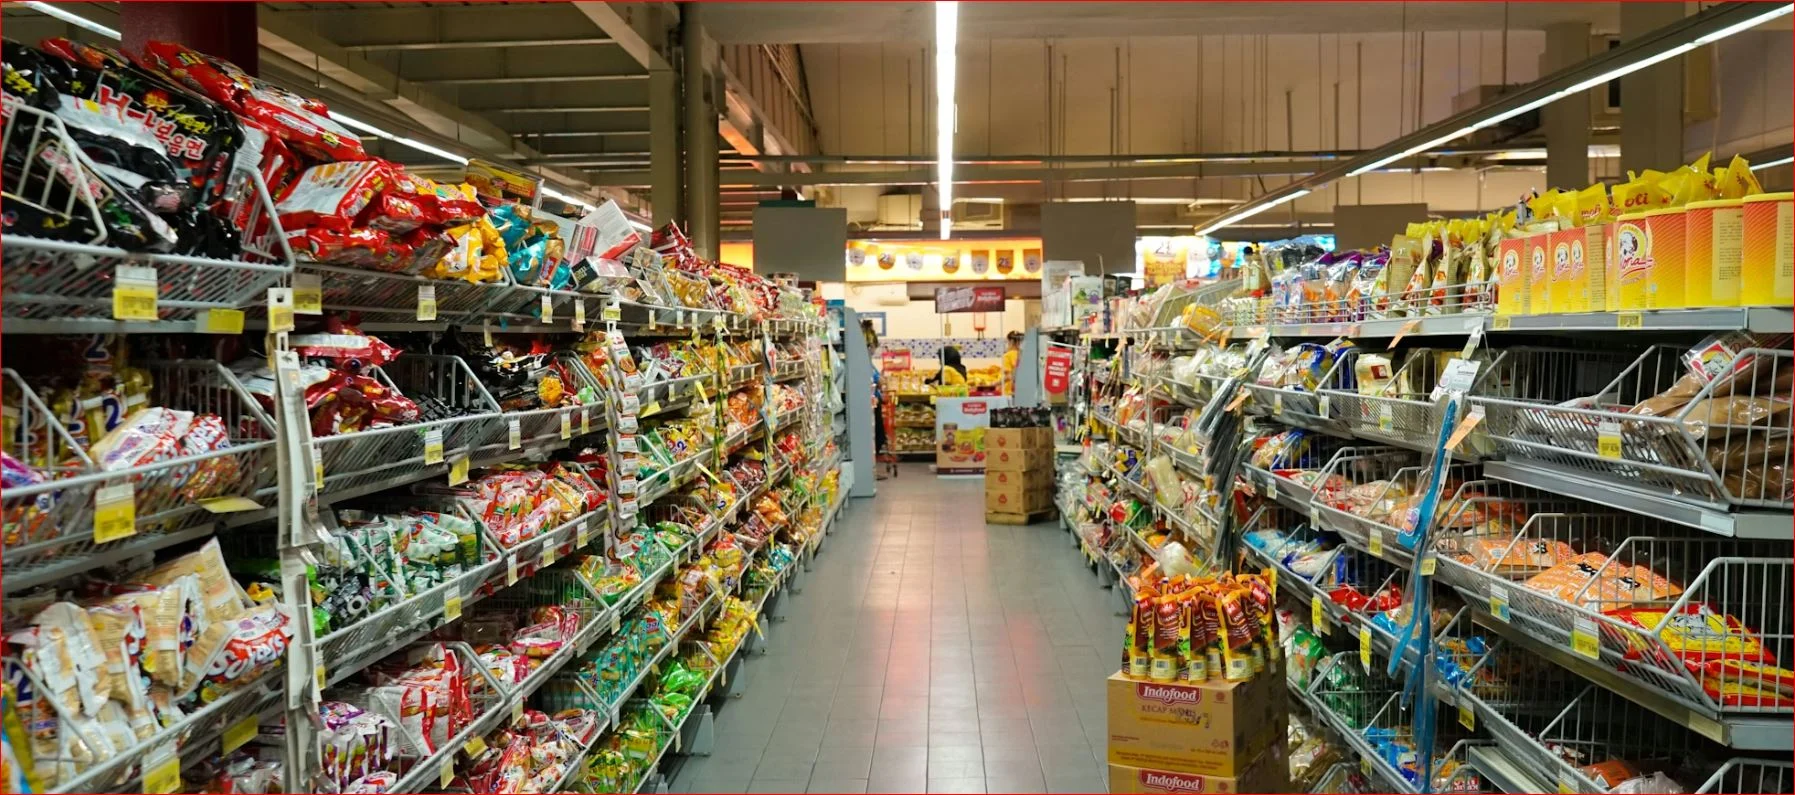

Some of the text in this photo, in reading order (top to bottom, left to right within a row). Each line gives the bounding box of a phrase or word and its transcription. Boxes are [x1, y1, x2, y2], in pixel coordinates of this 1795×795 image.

[1143, 685, 1197, 703] Indofood
[1141, 704, 1167, 714] KECAP
[1146, 773, 1200, 791] Indofood
